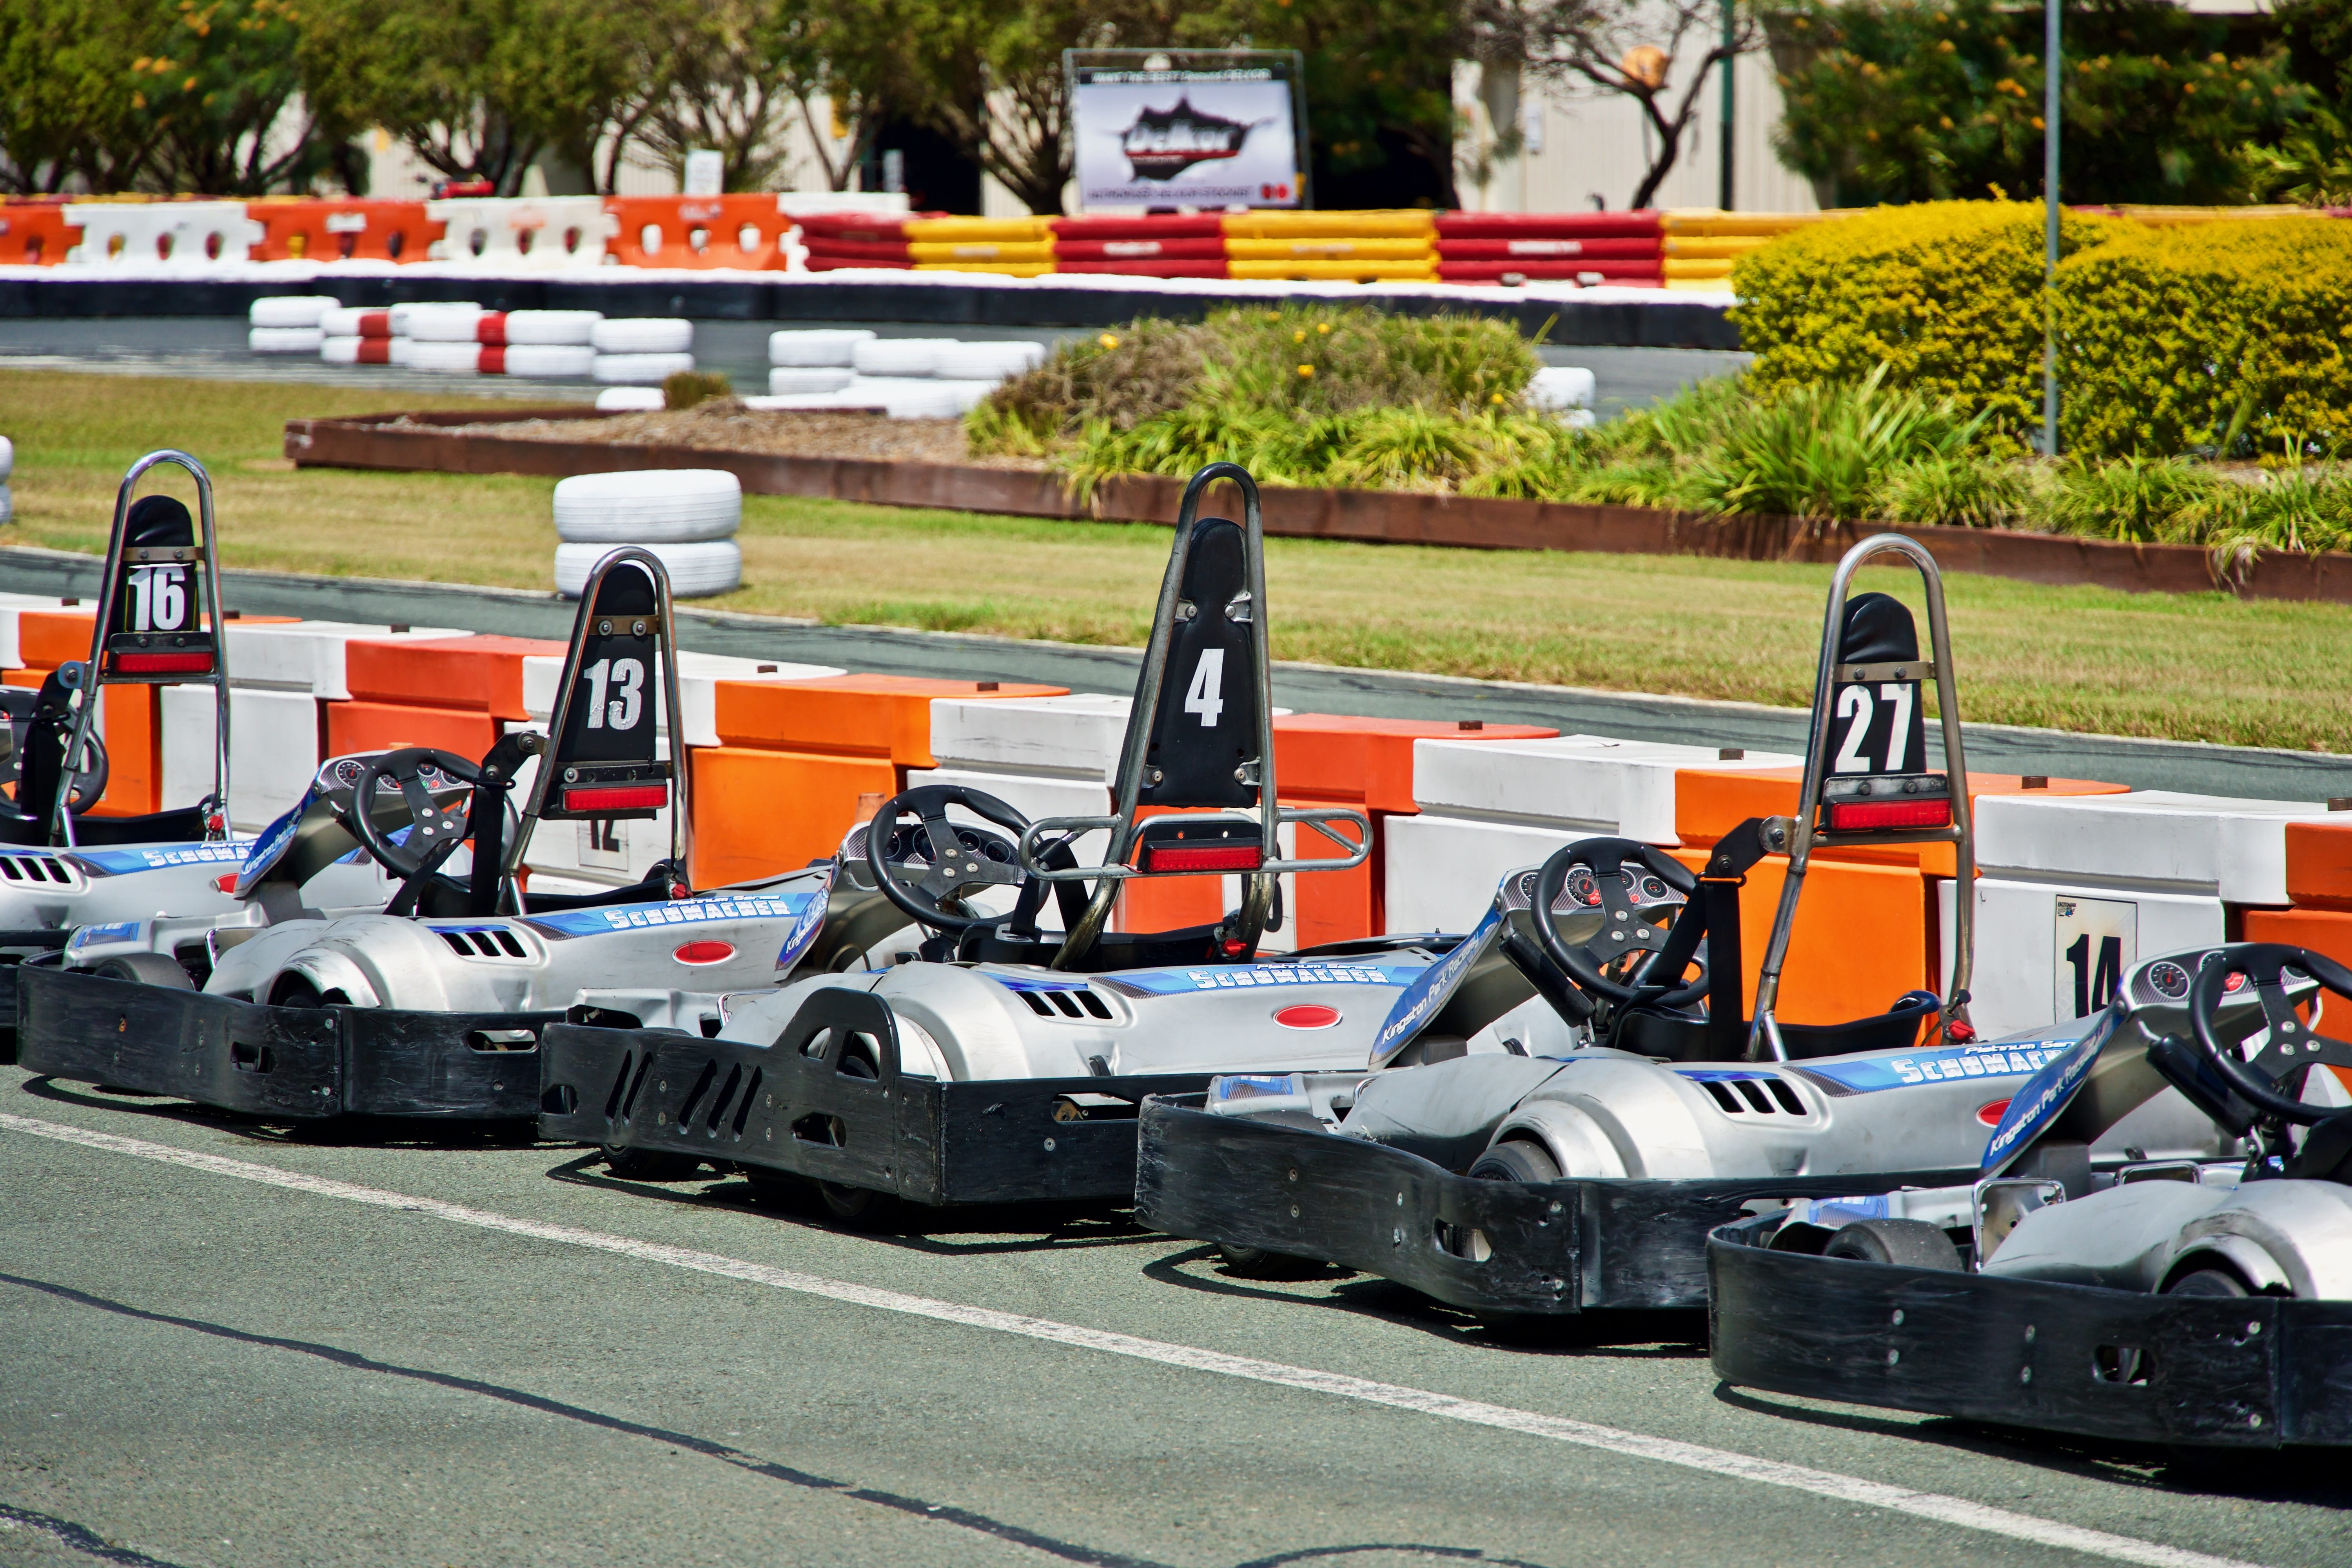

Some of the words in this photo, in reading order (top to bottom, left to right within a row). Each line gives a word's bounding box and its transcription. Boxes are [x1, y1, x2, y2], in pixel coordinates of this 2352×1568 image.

[128, 566, 185, 631] 16
[584, 659, 644, 730] 13
[1184, 648, 1224, 726] 4
[1835, 684, 1913, 773] 27
[141, 846, 253, 867] SCHUMA
[603, 900, 791, 929] SCHUMACHER
[667, 897, 728, 906] Platinum
[1187, 969, 1390, 989] SCHUMACHER
[1382, 997, 1427, 1045] Kingston
[1429, 972, 1447, 1003] Park
[1449, 931, 1479, 978] Raceway
[1965, 1043, 2036, 1054] Platinum
[1989, 1103, 2041, 1157] Kingston
[2041, 1077, 2065, 1110] Park
